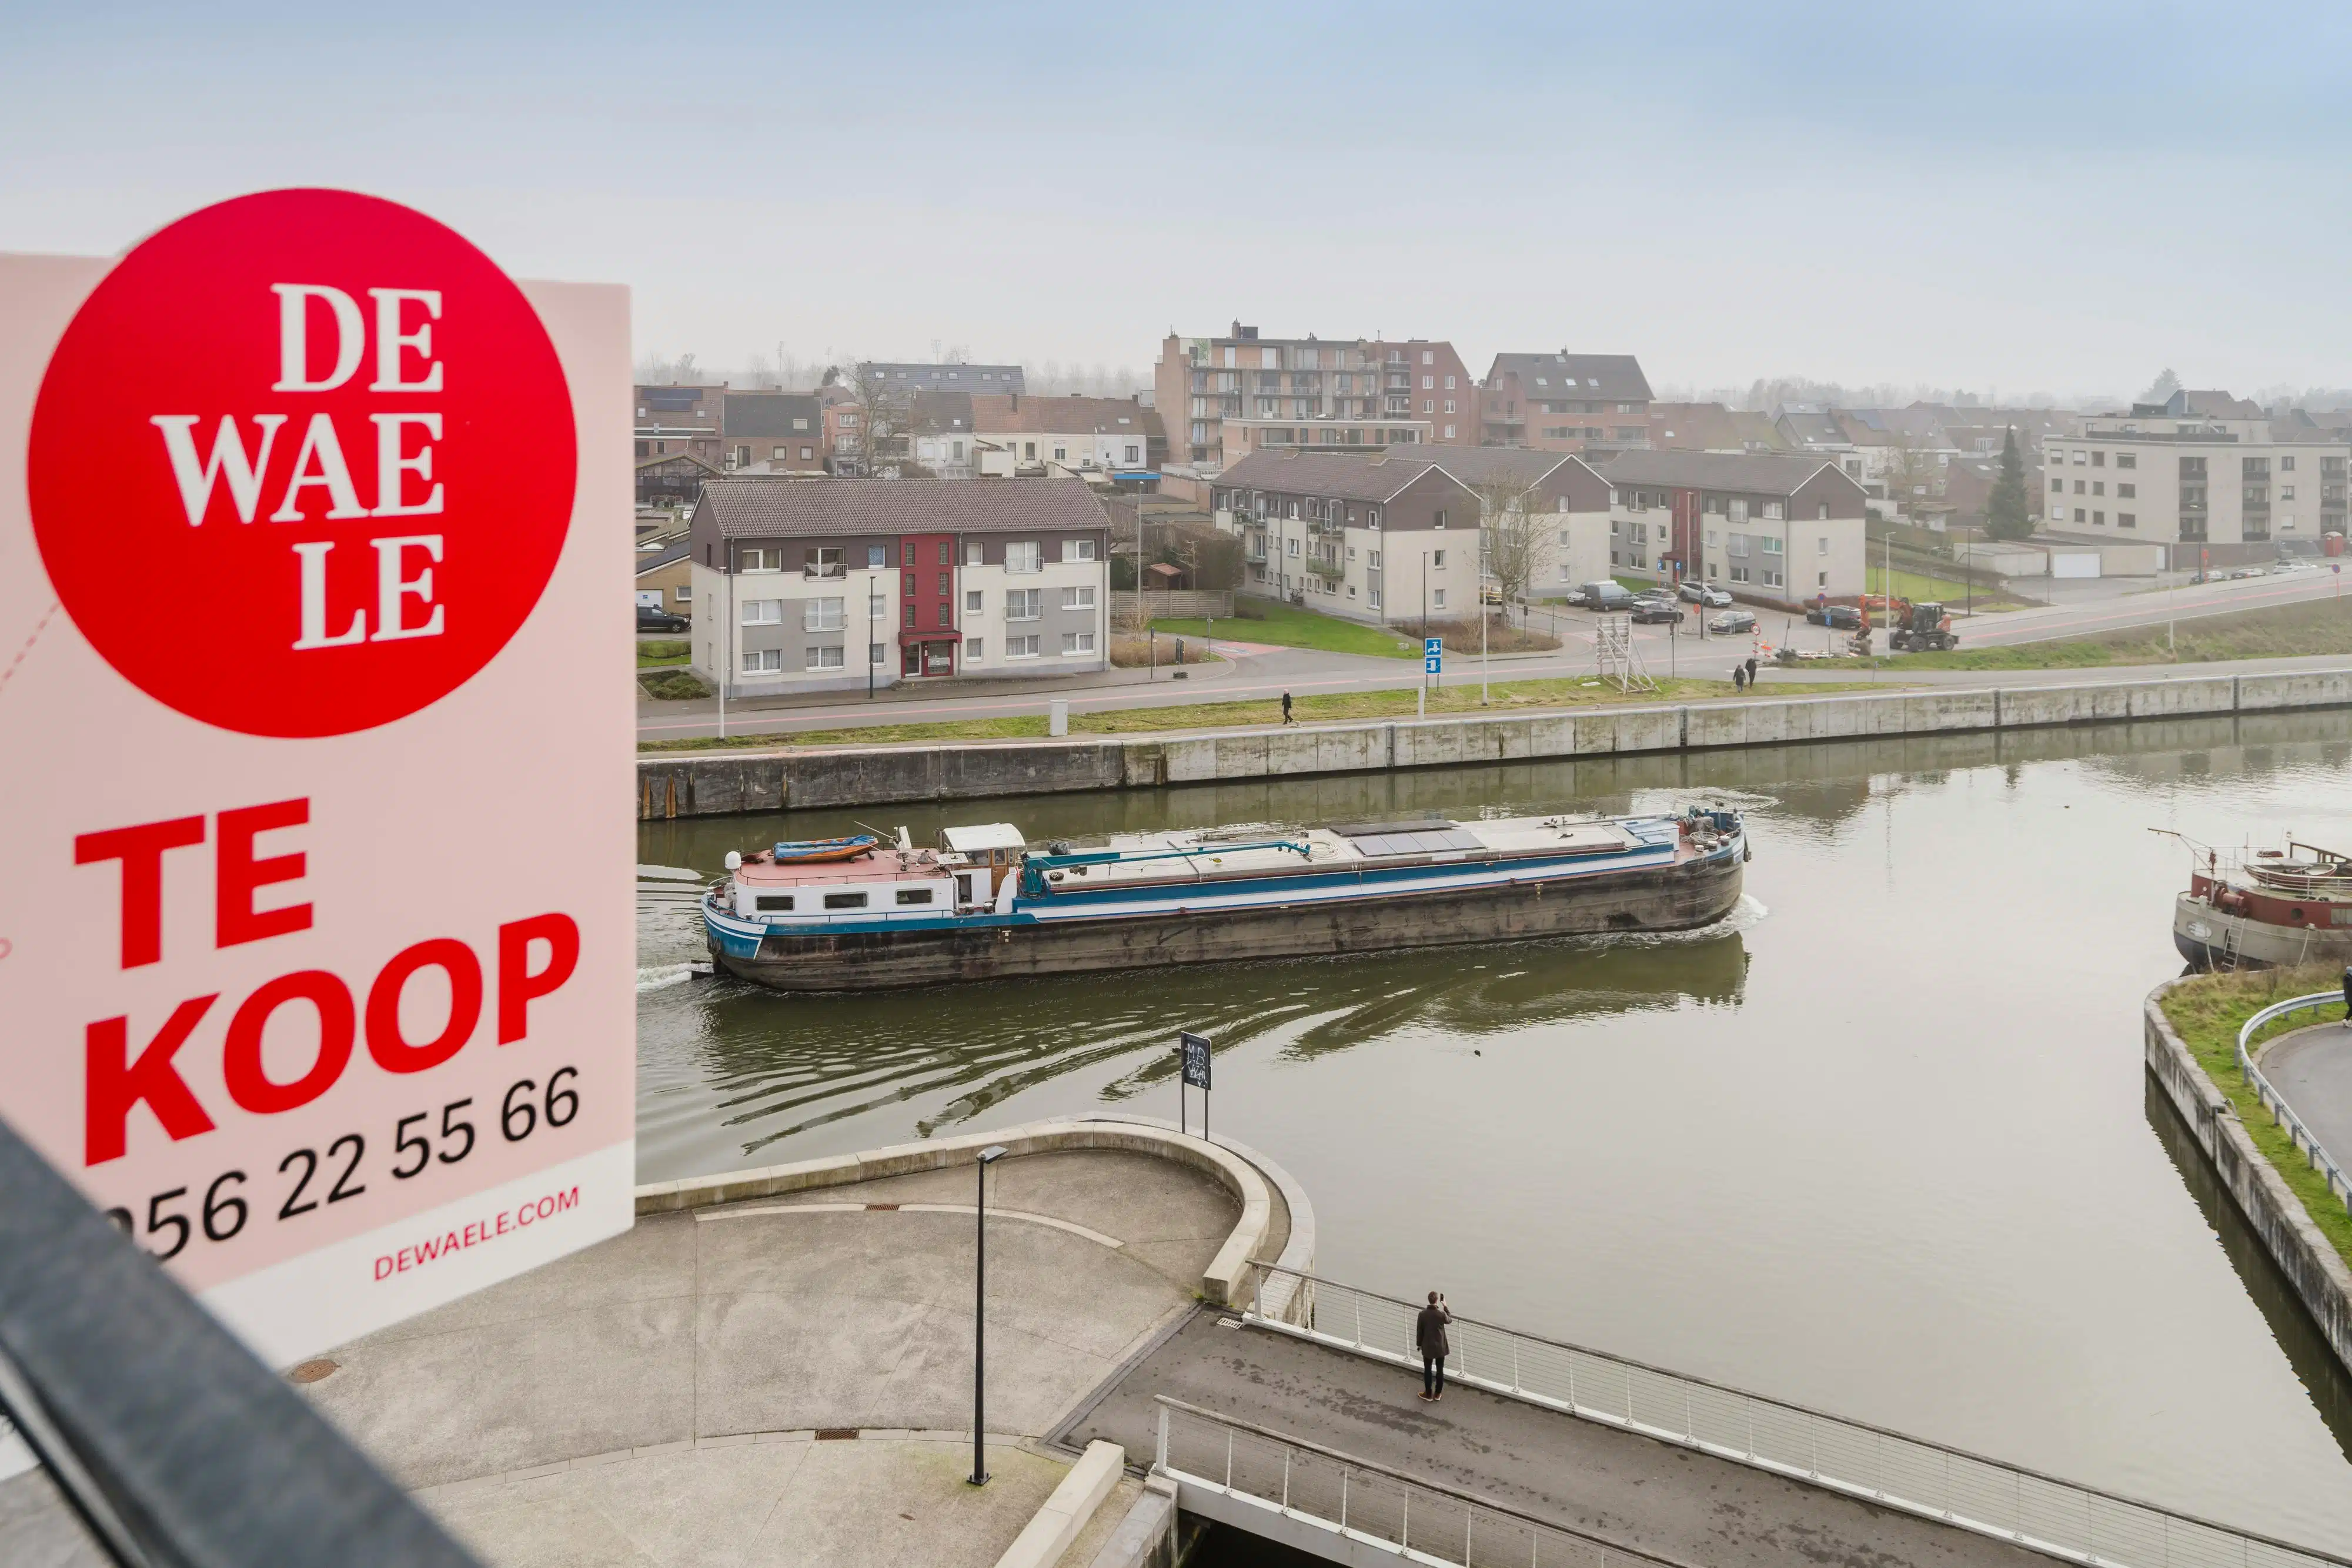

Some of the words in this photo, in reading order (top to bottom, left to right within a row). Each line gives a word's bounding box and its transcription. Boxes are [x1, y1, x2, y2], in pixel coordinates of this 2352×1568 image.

[272, 283, 443, 392] DE
[151, 413, 444, 527] WAE
[293, 534, 445, 650] LE
[74, 796, 314, 970] TE
[84, 911, 581, 1168] KOOP
[106, 1170, 248, 1262] 56
[279, 1134, 366, 1221] 22
[392, 1098, 475, 1179] 55
[502, 1066, 579, 1142] 66
[374, 1186, 580, 1281] DEWAELE.COM
